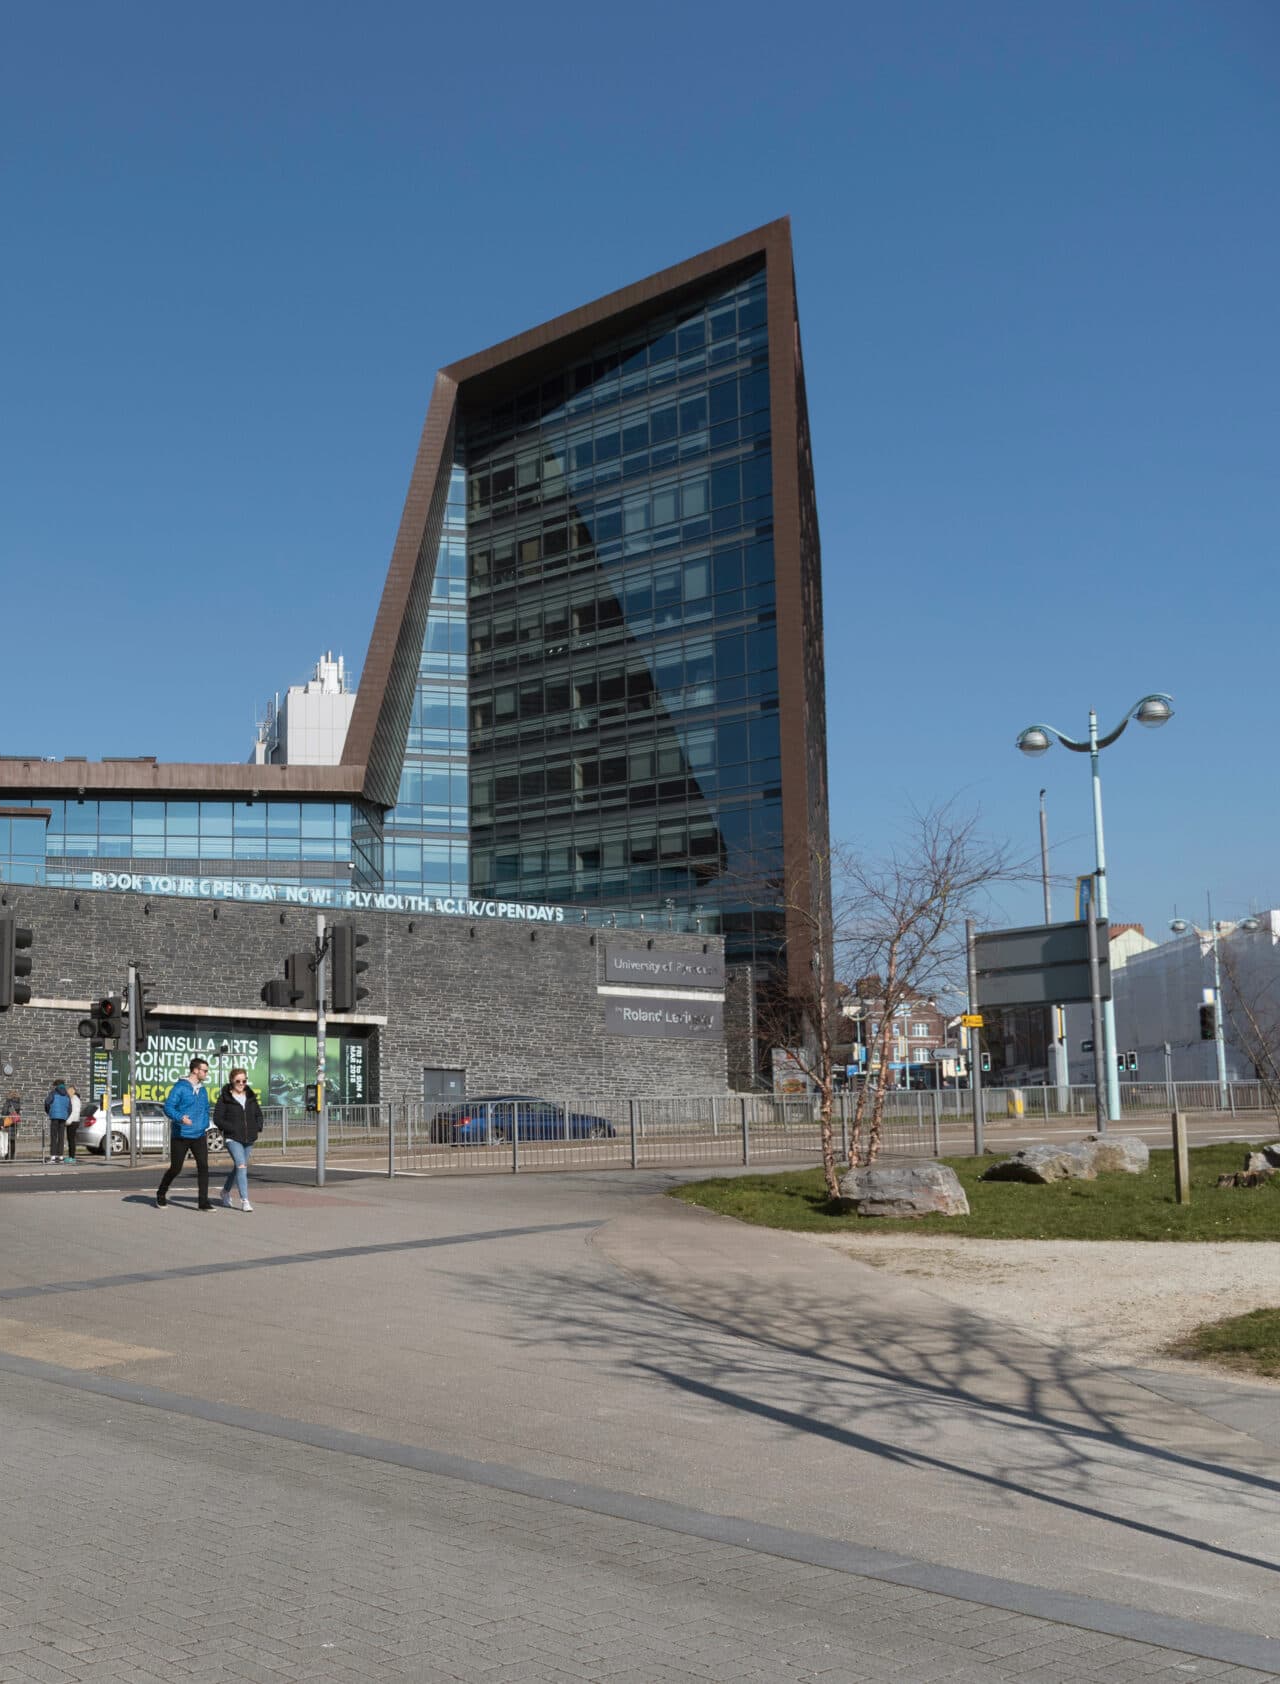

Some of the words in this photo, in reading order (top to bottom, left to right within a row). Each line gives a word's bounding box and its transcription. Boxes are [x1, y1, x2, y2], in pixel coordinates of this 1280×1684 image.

[91, 871, 142, 890] BOOK
[149, 876, 195, 895] YOUR
[249, 882, 278, 900] DAY
[285, 887, 331, 904] NOW!
[623, 1007, 662, 1022] Roland
[147, 1035, 216, 1052] NINSULA
[220, 1038, 258, 1055] ARTS
[128, 1066, 180, 1082] MUSIC
